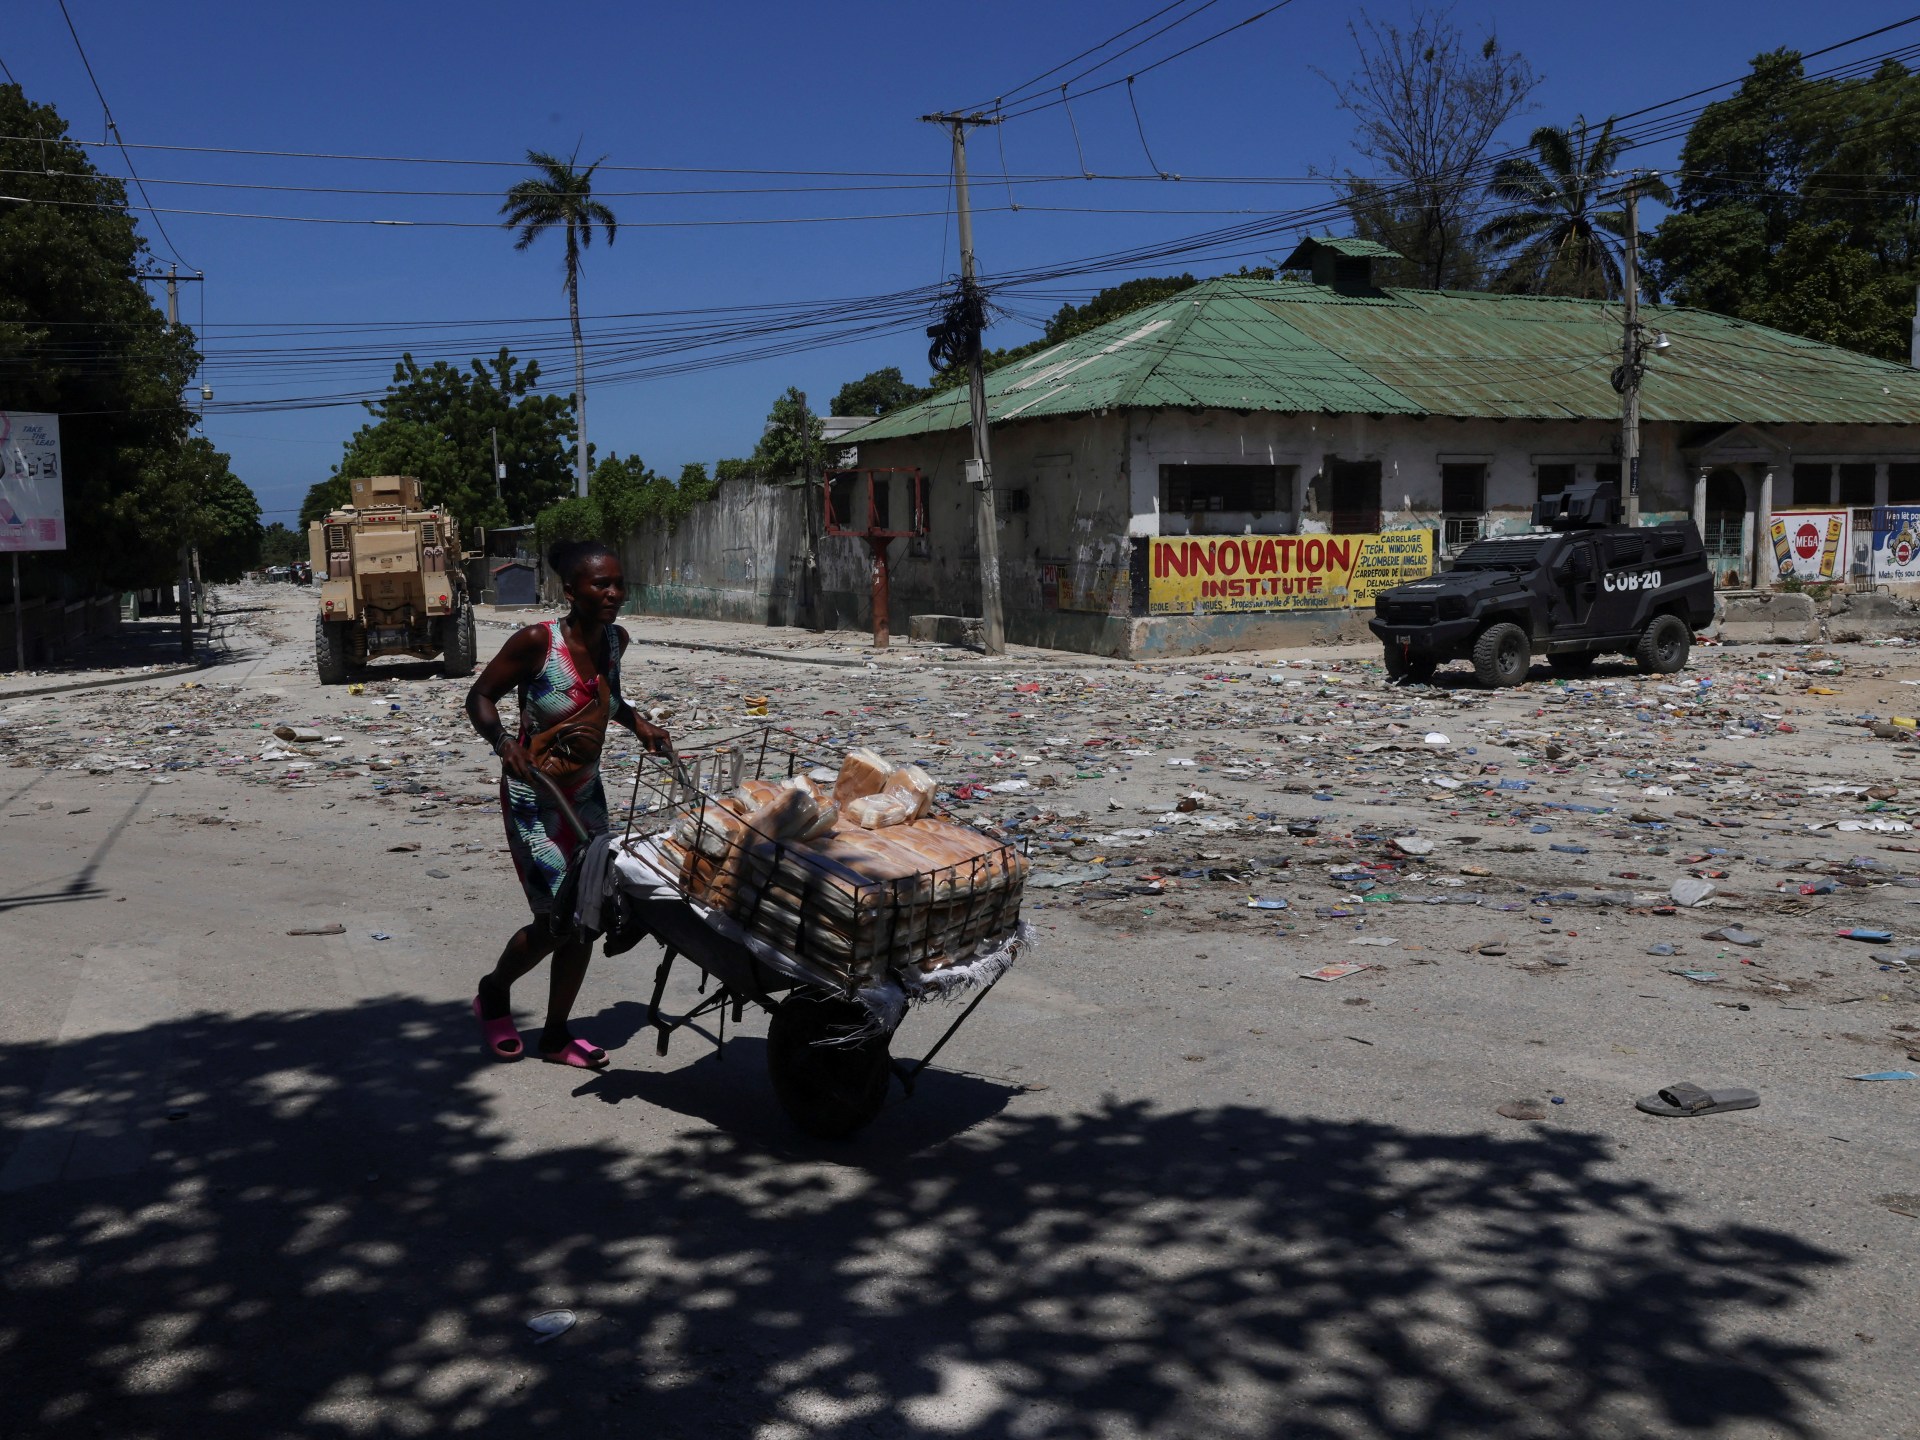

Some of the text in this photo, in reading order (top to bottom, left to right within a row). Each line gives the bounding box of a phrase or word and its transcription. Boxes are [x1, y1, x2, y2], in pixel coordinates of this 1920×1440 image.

[22, 425, 44, 433] TAKE
[32, 432, 47, 440] THE
[1380, 535, 1421, 543] CARRELAGE
[1796, 535, 1818, 548] MEGA
[1388, 543, 1423, 553] WINDOWS
[1155, 538, 1350, 578] INNOVATION
[1360, 556, 1400, 567] PLOMBERIE
[1355, 568, 1390, 578] CARREFOUR
[1391, 567, 1399, 577] DE
[1367, 579, 1394, 587] DELMAS
[1603, 569, 1661, 592] COB-20
[1202, 577, 1322, 597] INSTITUTE
[1150, 602, 1169, 611] ECOLE
